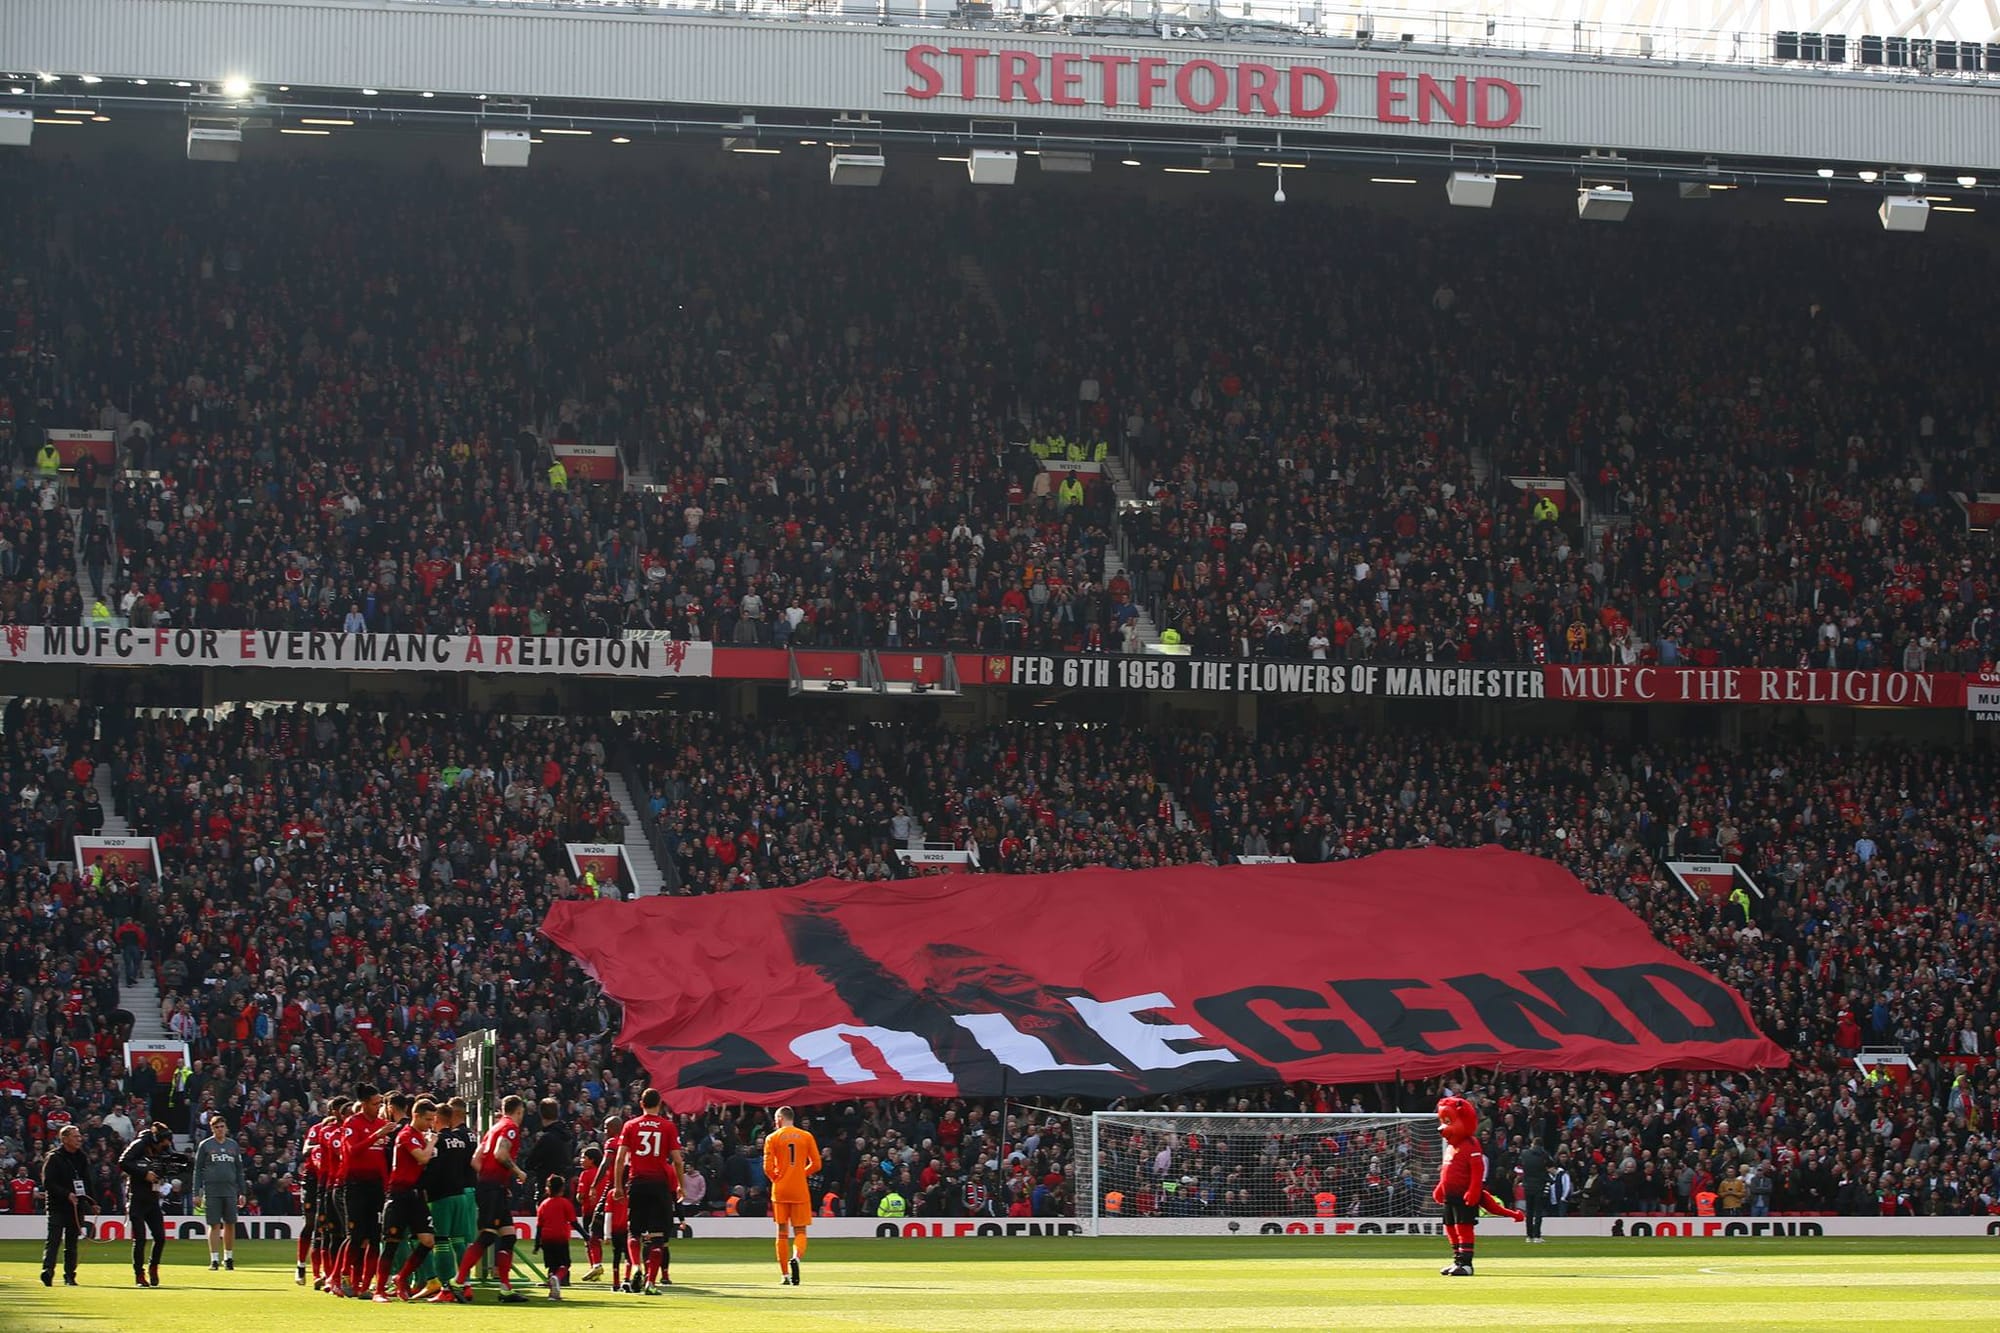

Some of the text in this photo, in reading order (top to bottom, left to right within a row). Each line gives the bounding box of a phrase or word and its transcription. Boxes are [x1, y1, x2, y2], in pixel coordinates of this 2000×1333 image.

[904, 44, 1523, 129] STRETFORD END
[465, 636, 484, 663] A
[495, 637, 650, 669] RELIGION
[1011, 656, 1545, 699] FEB 6TH 1958 THE FLOWERS OF MANCHESTER
[1561, 666, 1934, 703] MUFC THE RELIGION
[635, 1131, 662, 1157] 31
[787, 1142, 796, 1167] 1
